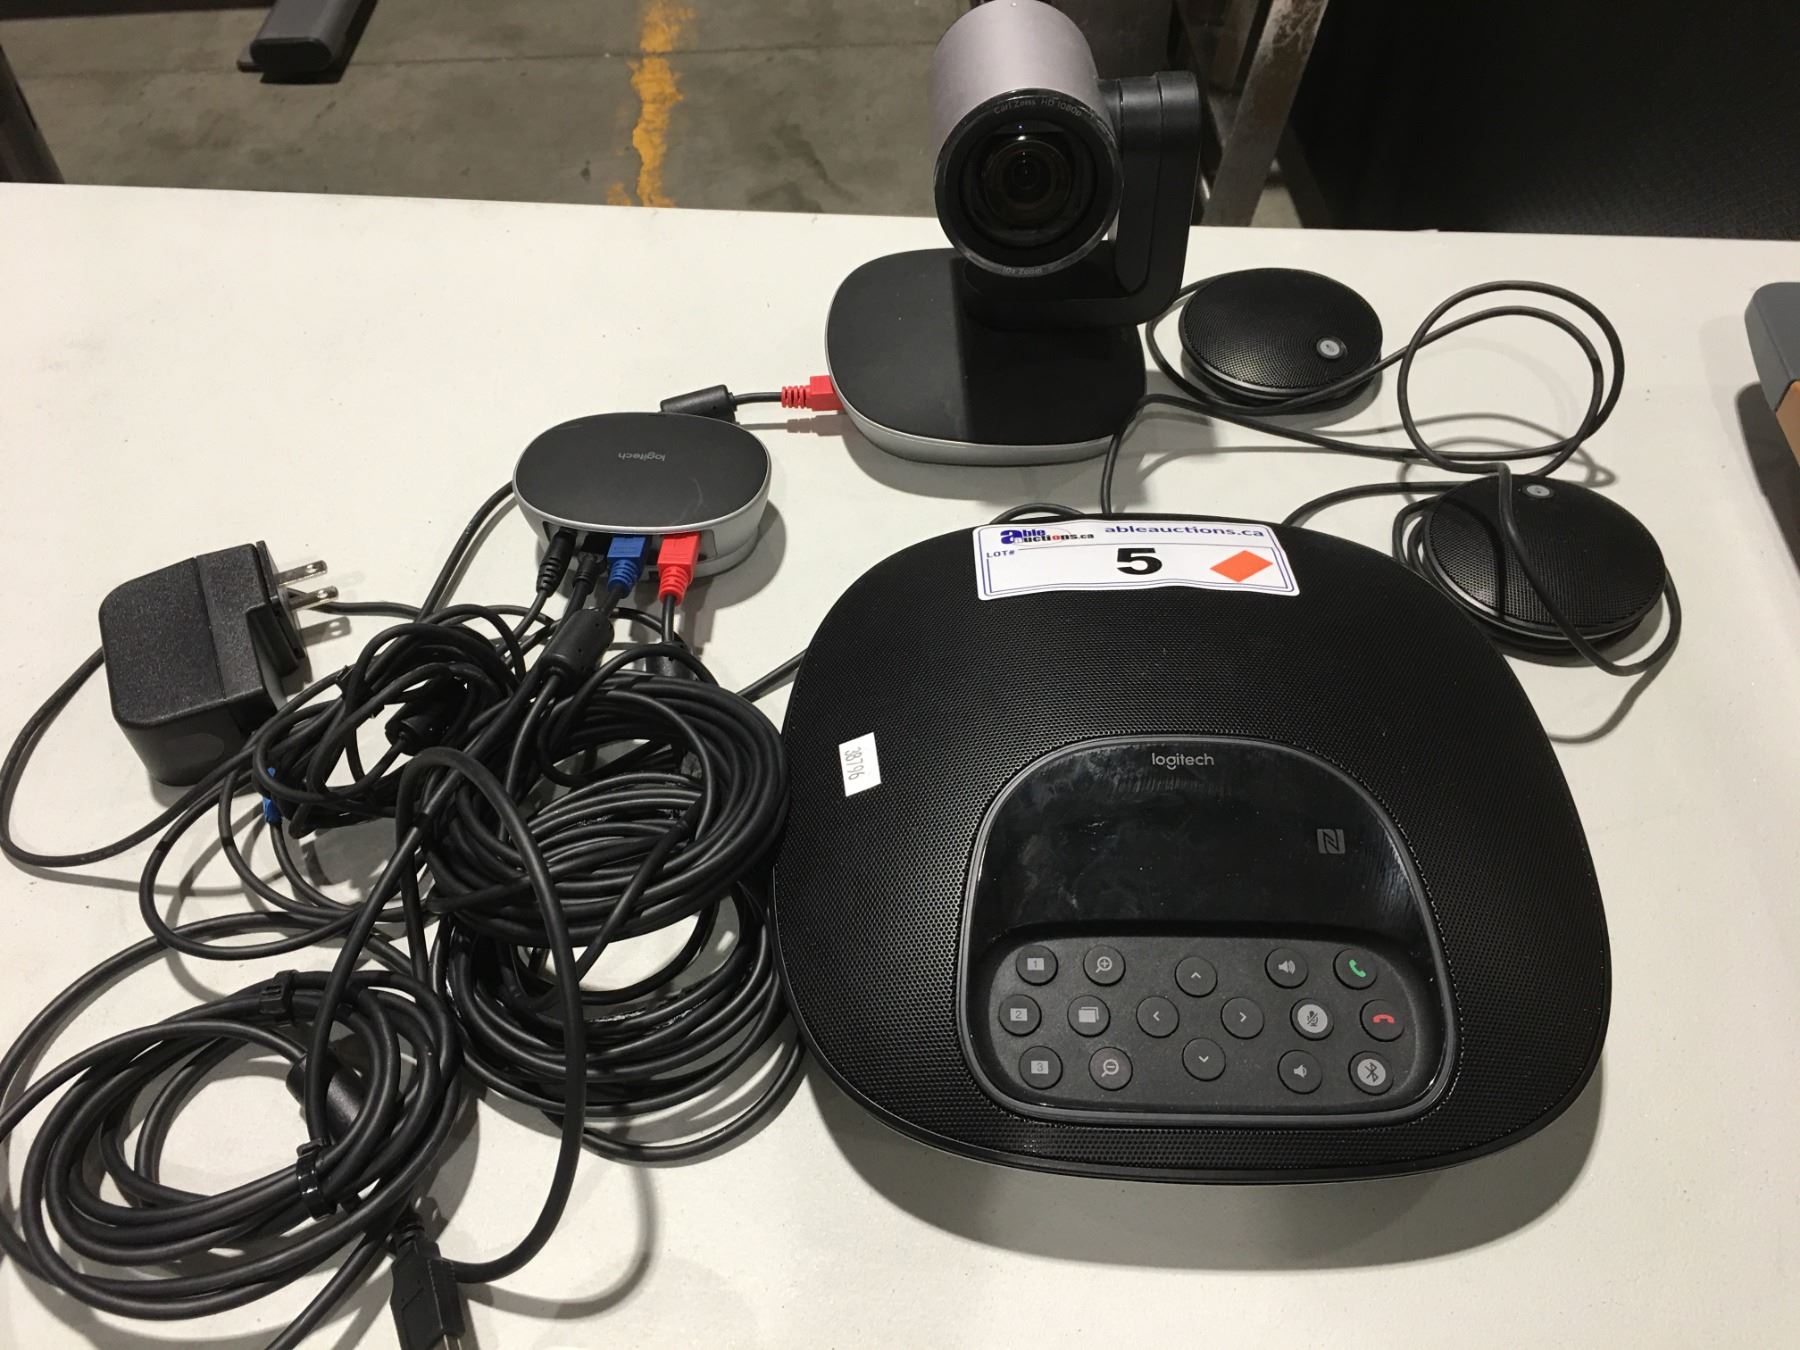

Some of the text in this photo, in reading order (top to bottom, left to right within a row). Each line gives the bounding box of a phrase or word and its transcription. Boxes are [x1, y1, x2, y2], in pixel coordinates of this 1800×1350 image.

[993, 102, 1012, 114] Carl
[1014, 99, 1036, 108] Zeiss
[1057, 101, 1083, 117] 1080p
[618, 451, 666, 461] logitech
[1104, 525, 1265, 538] ableauctions.ca
[986, 550, 1016, 558] LOT#
[1116, 547, 1163, 576] 5
[1151, 753, 1215, 770] logitech
